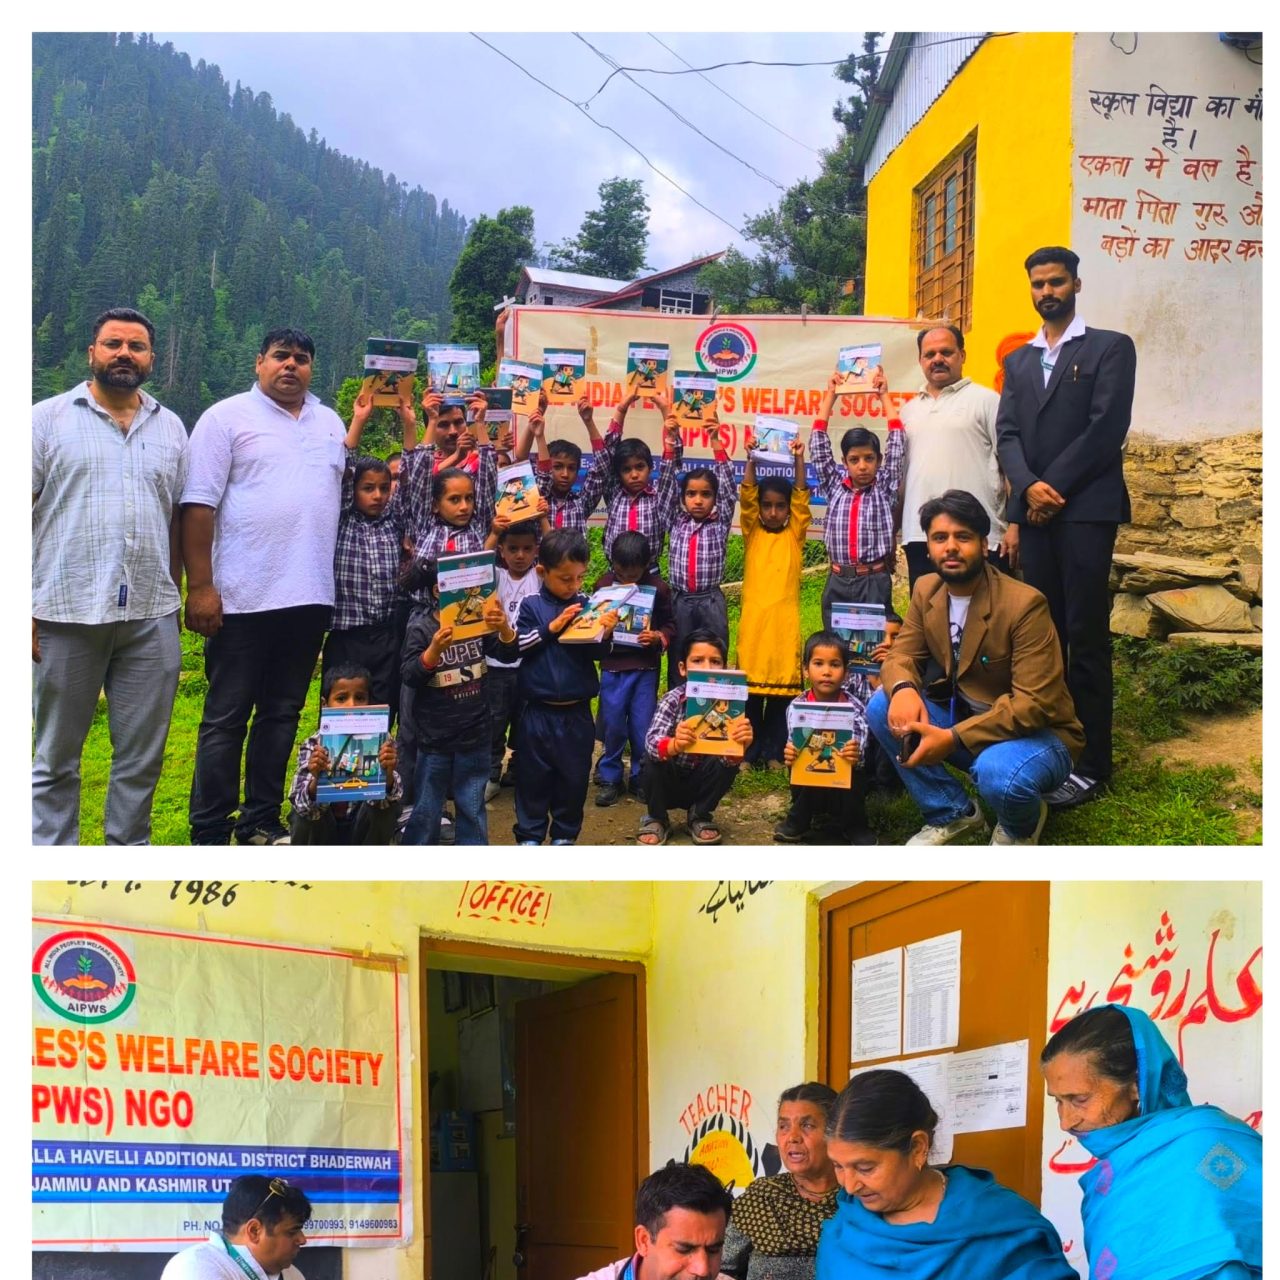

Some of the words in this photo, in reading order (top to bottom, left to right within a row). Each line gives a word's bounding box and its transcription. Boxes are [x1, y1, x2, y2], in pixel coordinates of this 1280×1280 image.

[1089, 90, 1140, 120] स्कूल
[1145, 84, 1198, 118] विद्या
[1205, 96, 1240, 119] का
[1078, 155, 1134, 178] एकता
[1082, 198, 1127, 221] माता
[1136, 189, 1181, 225] पिता
[1143, 237, 1175, 259] का
[469, 883, 545, 918] OFFICE
[67, 1002, 107, 1014] AIPWS
[32, 1028, 107, 1072] ES'S
[115, 1033, 259, 1079] WELFARE
[268, 1044, 384, 1087] SOCIETY
[125, 1089, 194, 1129] NGO
[679, 1083, 752, 1136] TEACHER
[71, 1149, 139, 1165] HAVELLI
[145, 1151, 237, 1168] ADDITIONAL
[241, 1153, 306, 1169] DISTRICT
[310, 1154, 391, 1170] BHADERWAH
[32, 1177, 92, 1193] JAMMU
[97, 1178, 131, 1193] AND
[136, 1178, 208, 1193] KASHMIR
[349, 1219, 398, 1230] 9149600983
